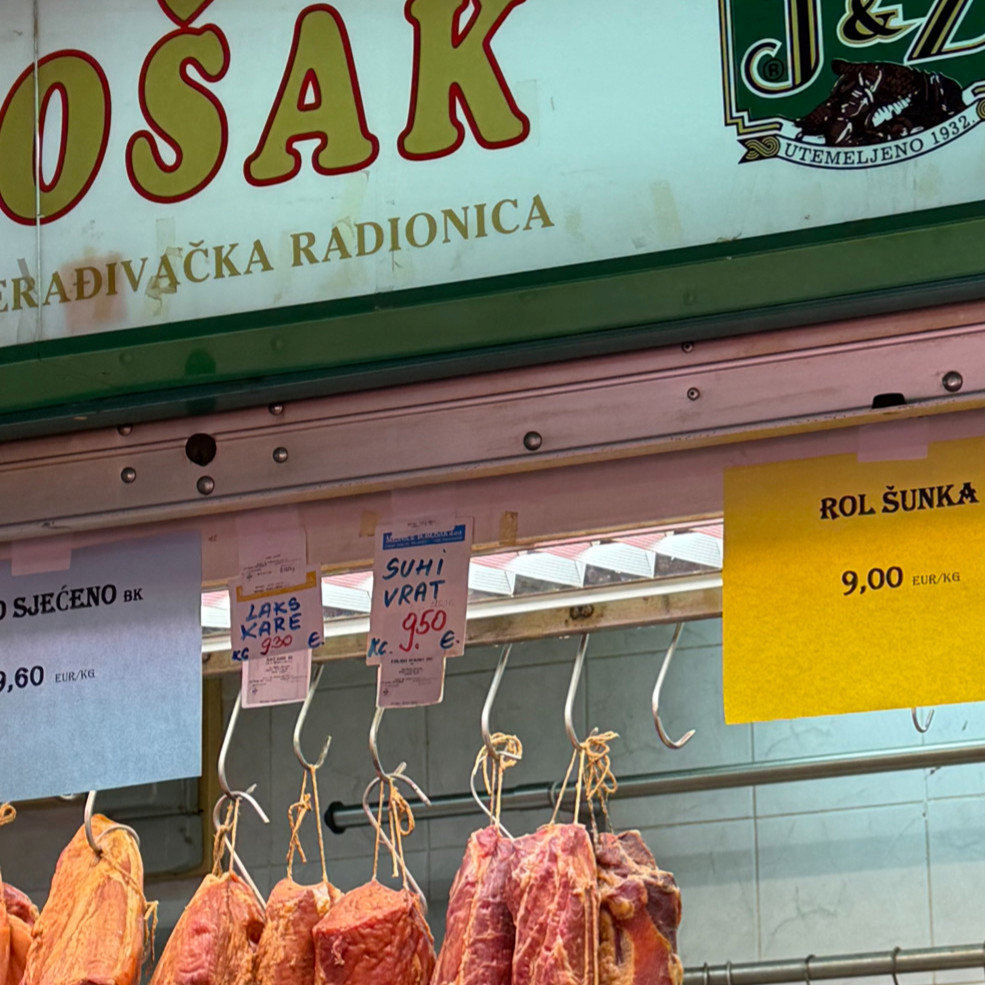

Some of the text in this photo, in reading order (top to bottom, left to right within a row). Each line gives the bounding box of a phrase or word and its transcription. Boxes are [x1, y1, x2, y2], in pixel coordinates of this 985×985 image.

[784, 115, 976, 166] UTEMELJENO 1932.
[290, 193, 554, 268] RADIONICA
[820, 481, 980, 520] ROL ŠUNKA
[382, 549, 447, 581] SUHI
[384, 580, 445, 608] VRAT
[841, 566, 961, 596] 9,00 EUR/KG
[12, 583, 117, 619] SJEĆENO
[123, 588, 144, 603] BK
[245, 597, 301, 622] LAKS
[241, 613, 302, 640] KARE
[54, 669, 95, 684] EUR/KG
